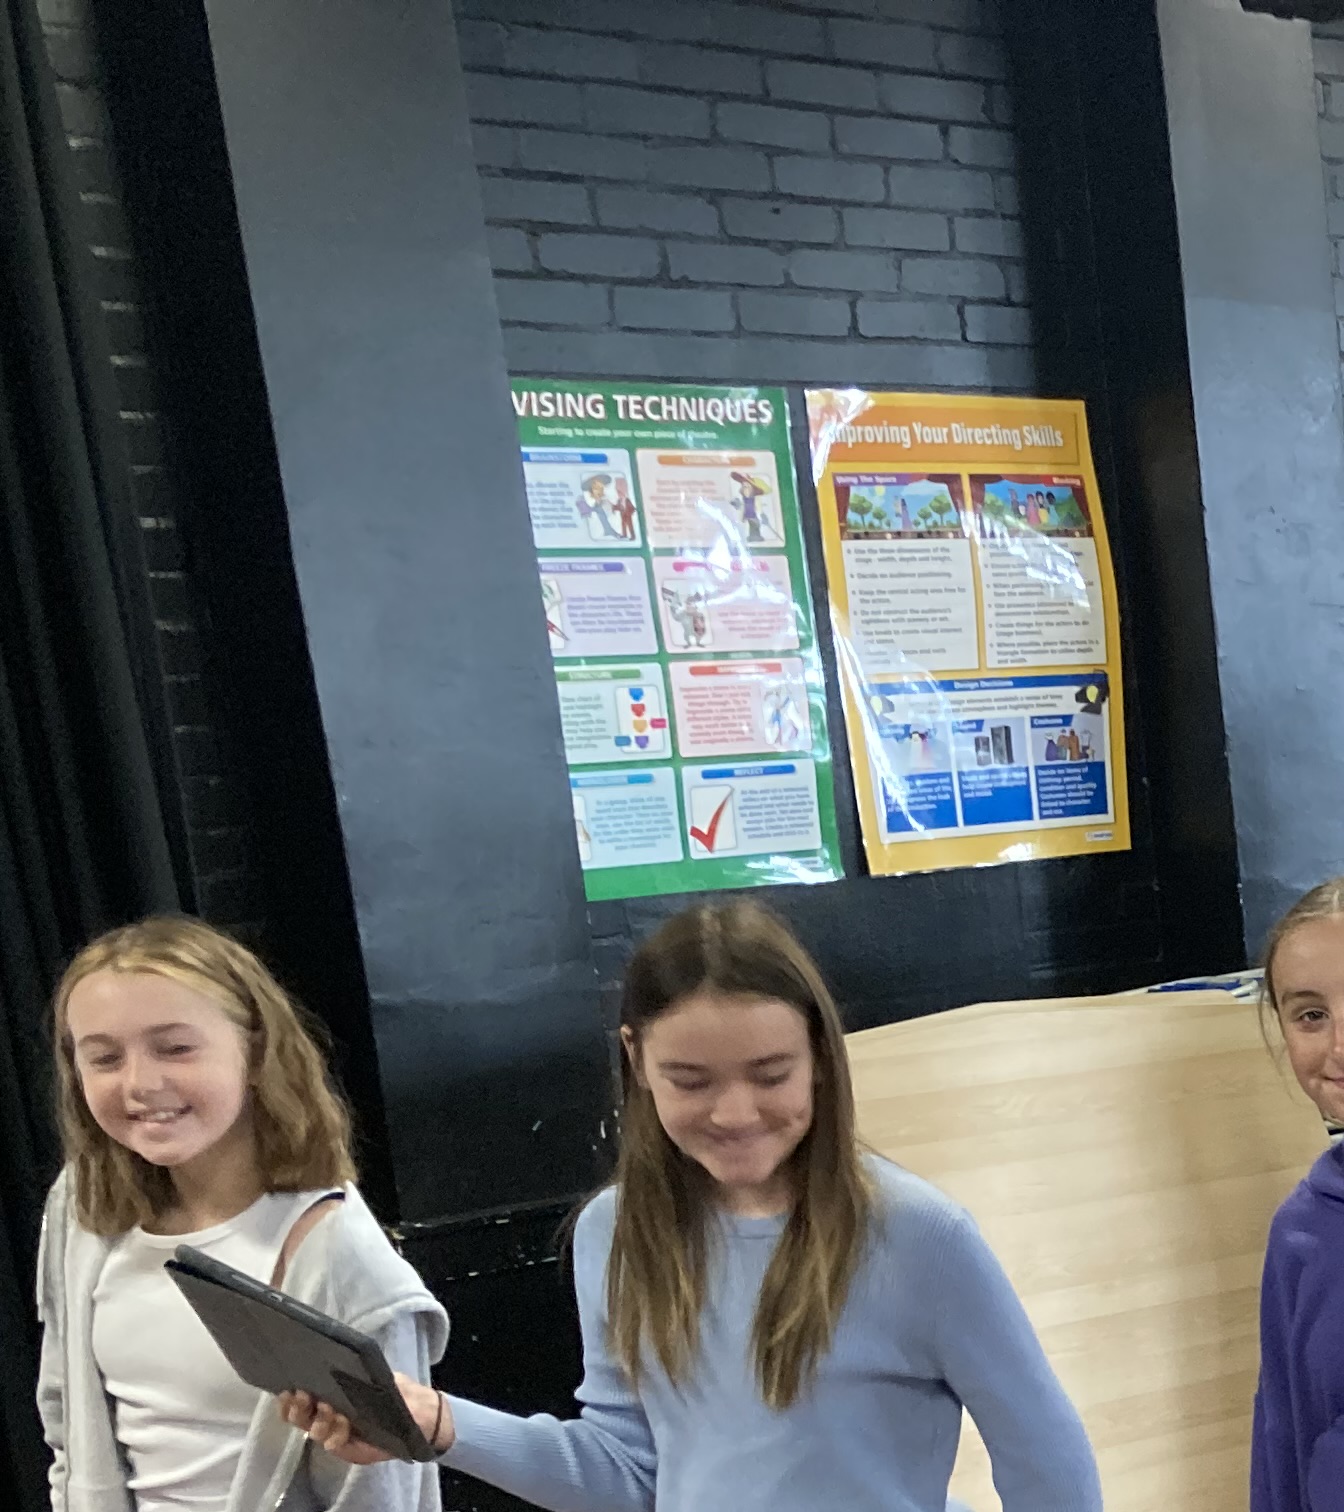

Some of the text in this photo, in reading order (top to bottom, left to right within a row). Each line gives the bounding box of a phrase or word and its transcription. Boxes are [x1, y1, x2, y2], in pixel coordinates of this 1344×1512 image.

[511, 390, 773, 426] VISING TECHNIQUES
[831, 420, 1064, 450] mproving Your Directing Skills
